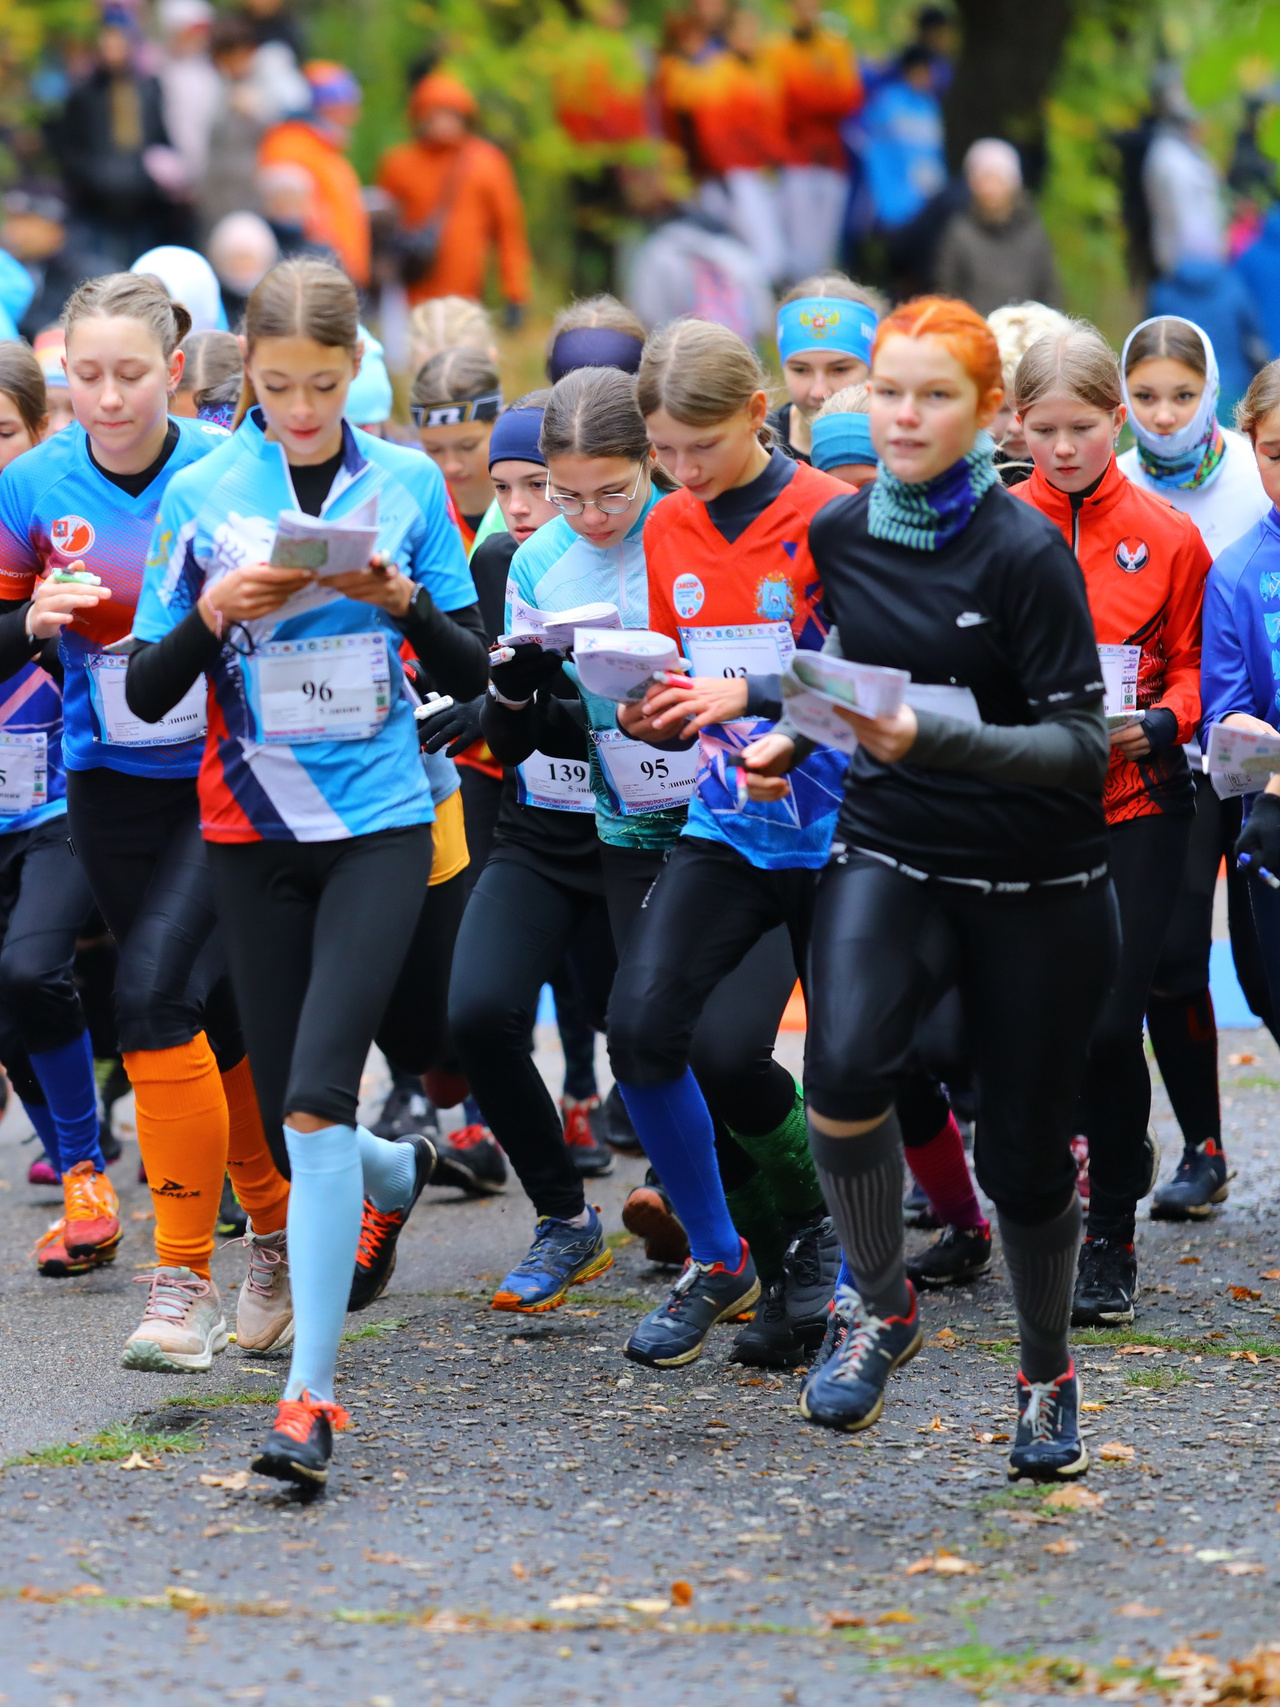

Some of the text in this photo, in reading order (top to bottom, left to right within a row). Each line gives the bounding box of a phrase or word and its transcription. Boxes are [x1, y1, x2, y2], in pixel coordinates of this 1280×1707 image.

[302, 679, 334, 704] 96
[168, 713, 198, 726] линия
[548, 763, 586, 782] 139
[640, 758, 670, 782] 95
[660, 778, 696, 790] 5 линия
